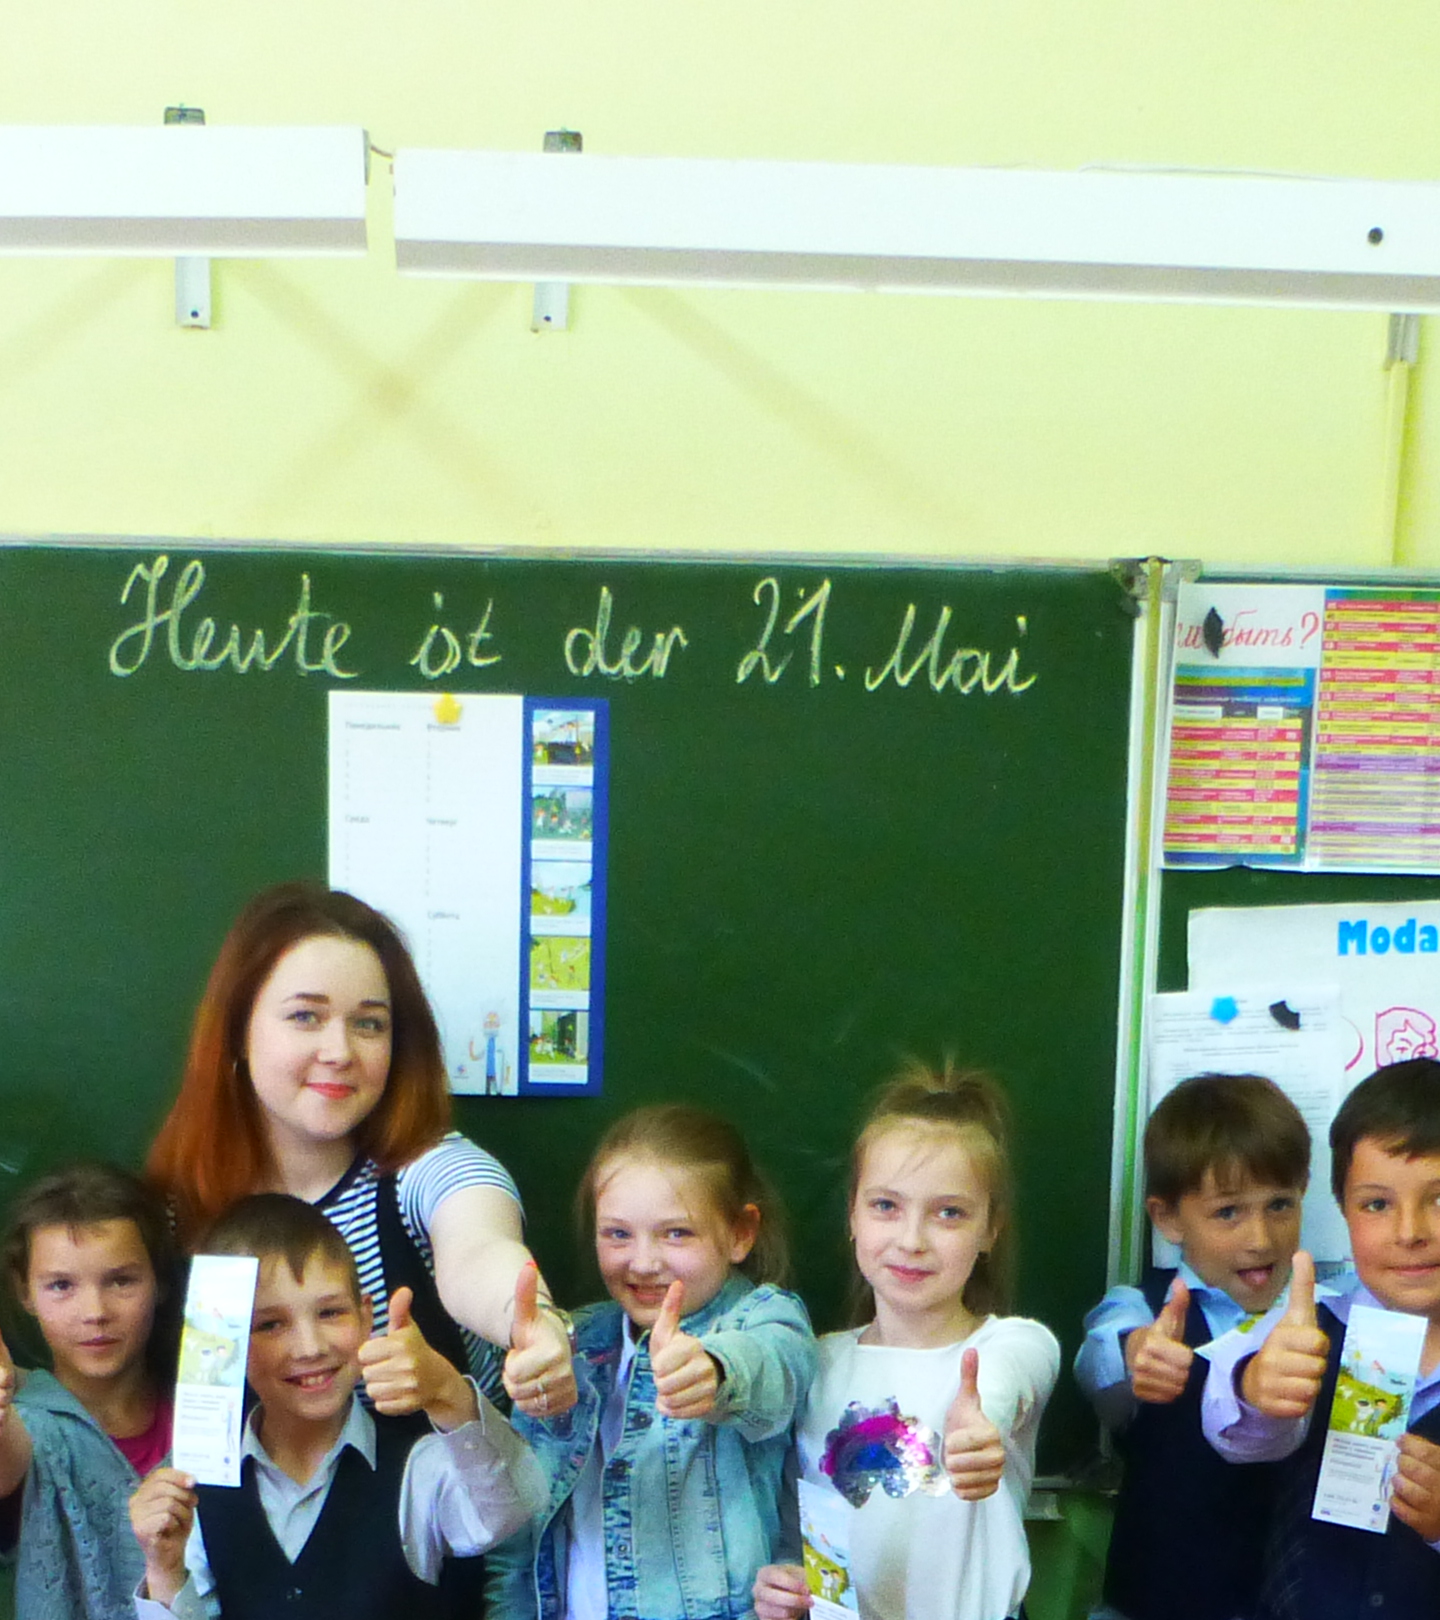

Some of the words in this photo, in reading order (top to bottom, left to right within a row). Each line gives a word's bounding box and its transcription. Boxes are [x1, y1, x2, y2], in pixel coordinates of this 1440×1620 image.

[109, 554, 358, 678] Heute
[409, 591, 502, 679] ist
[564, 586, 688, 683] der
[865, 603, 1037, 694] Mai
